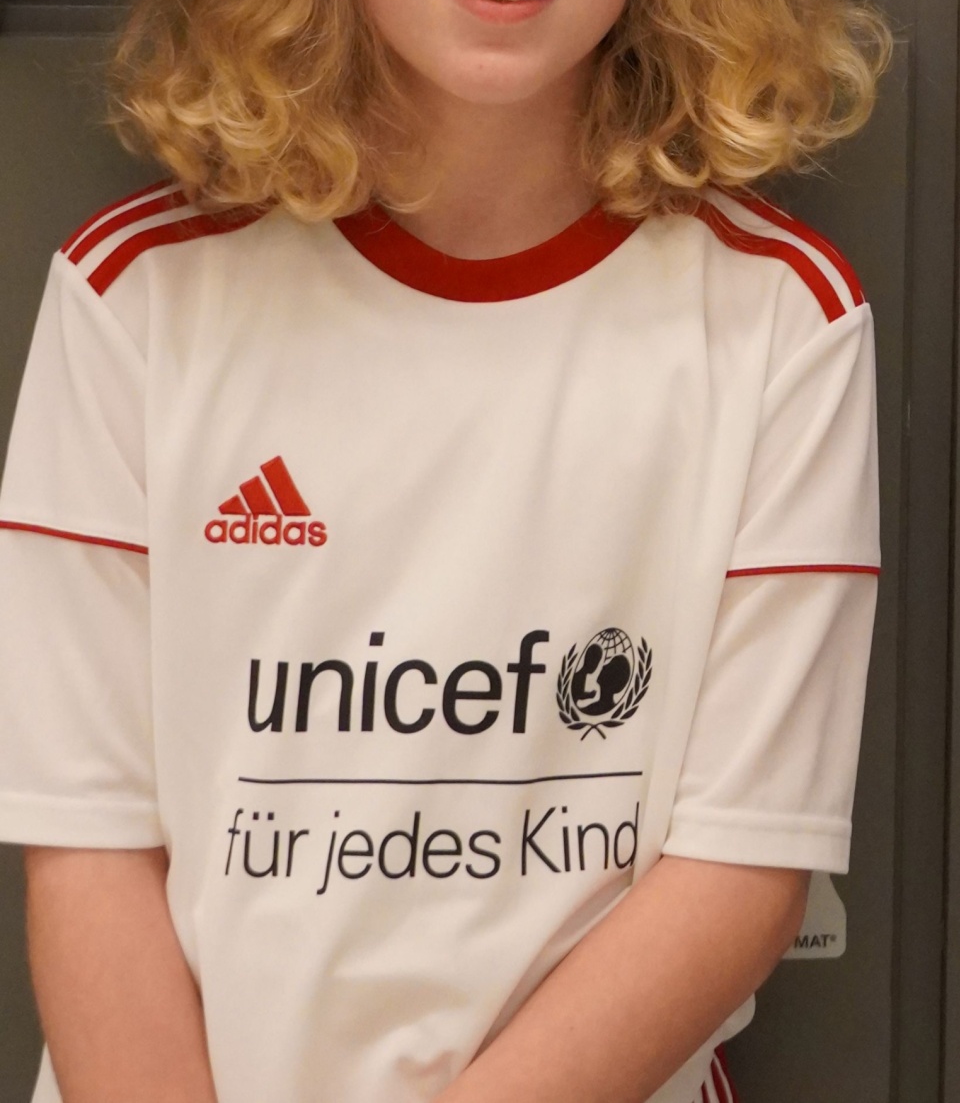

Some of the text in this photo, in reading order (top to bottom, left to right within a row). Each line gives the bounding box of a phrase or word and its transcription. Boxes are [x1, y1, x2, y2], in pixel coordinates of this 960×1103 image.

[204, 514, 327, 547] adidas
[247, 629, 550, 735] unicef
[224, 801, 641, 896] für jedes Kind
